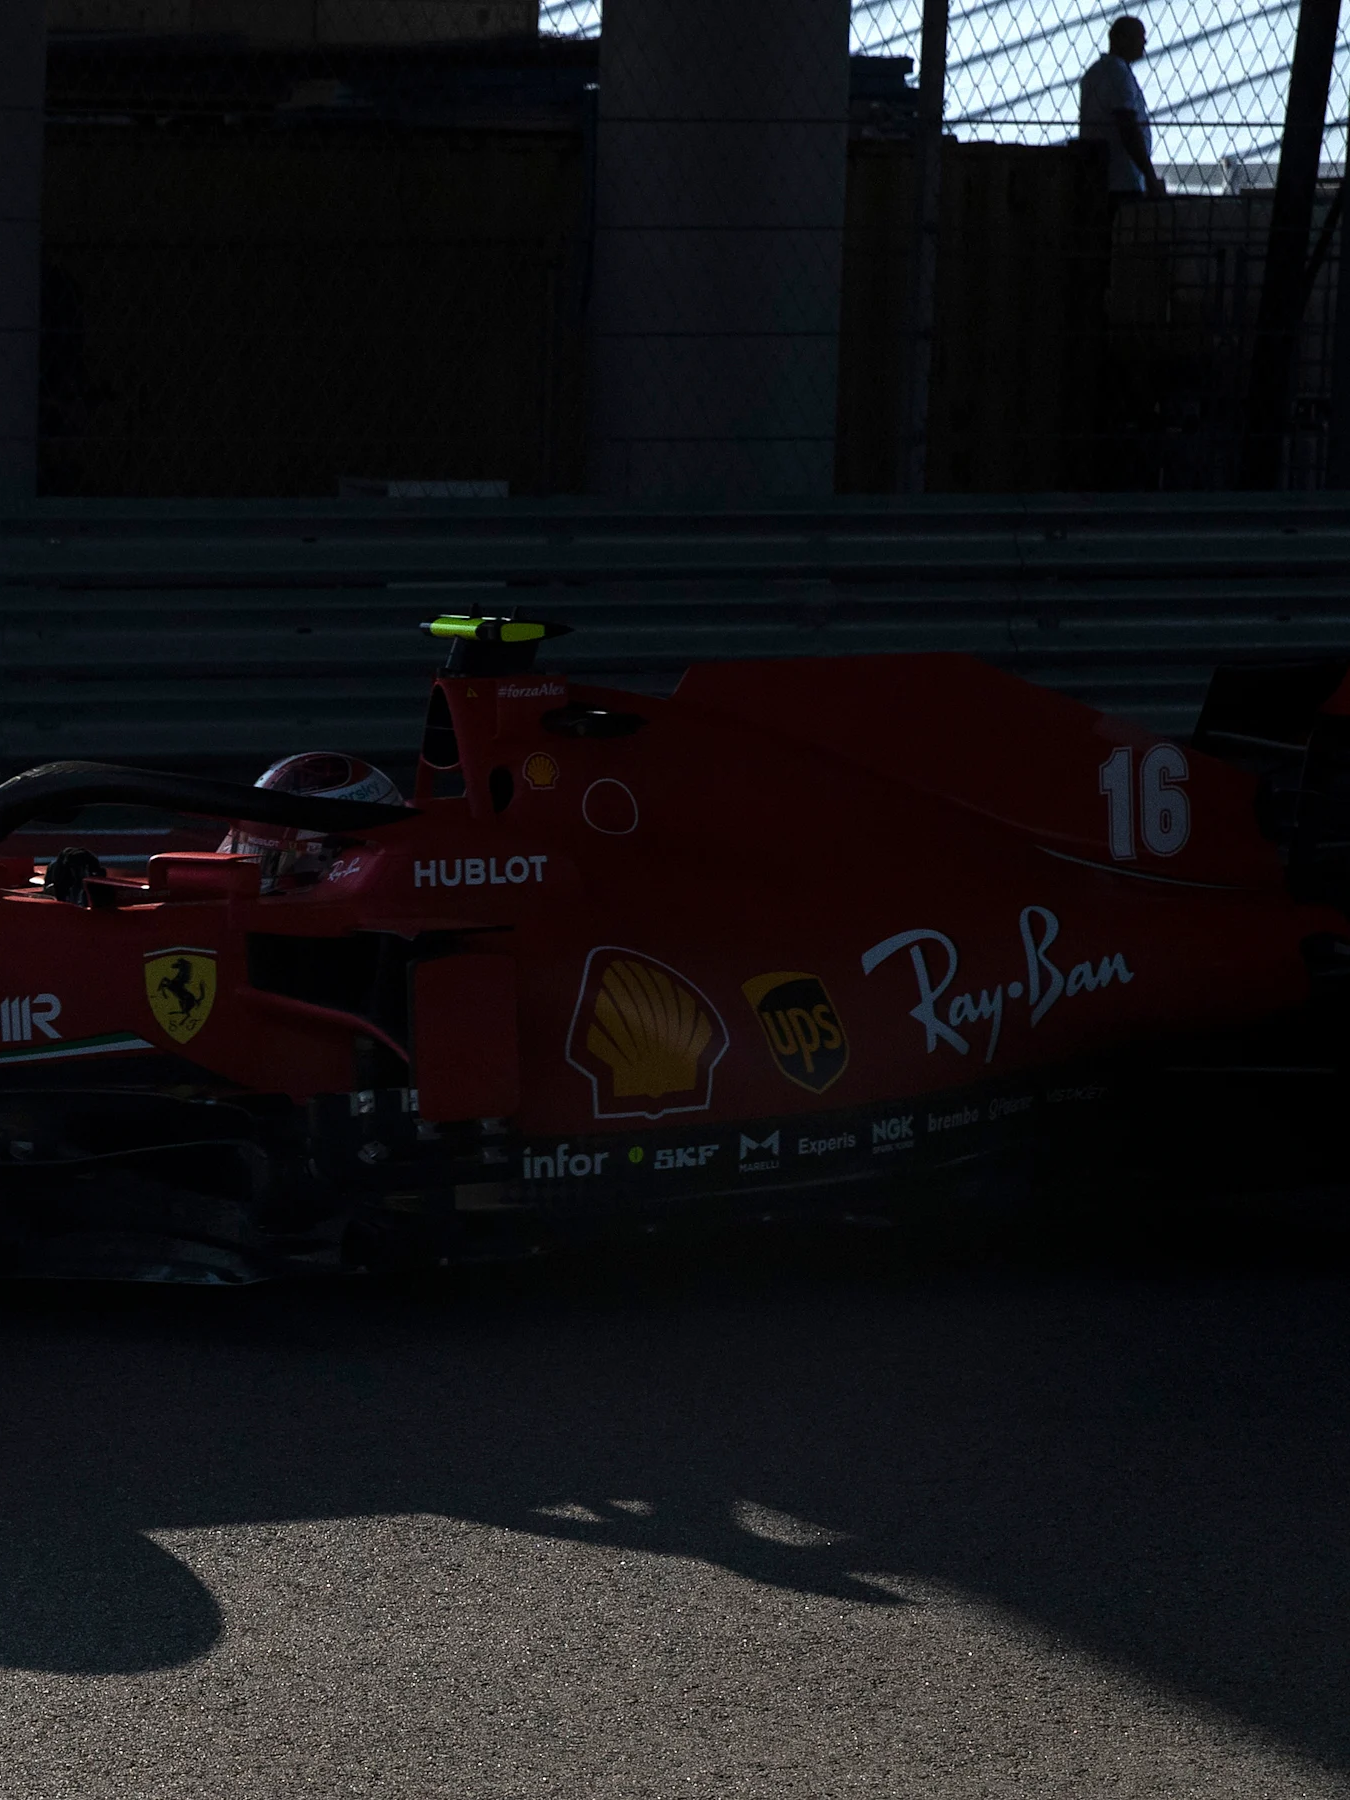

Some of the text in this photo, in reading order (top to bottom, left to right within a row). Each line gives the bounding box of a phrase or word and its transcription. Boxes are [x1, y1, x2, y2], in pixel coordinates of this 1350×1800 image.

[498, 682, 565, 699] #forzaAlex
[1099, 743, 1192, 861] 16
[414, 855, 548, 887] HUBLOT
[765, 1001, 842, 1073] ups
[872, 1113, 914, 1144] NGK
[928, 1106, 979, 1133] brembo
[654, 1144, 720, 1170] SKF
[798, 1132, 856, 1157] Experis
[523, 1144, 610, 1180] infor
[739, 1160, 781, 1173] MARELLI
